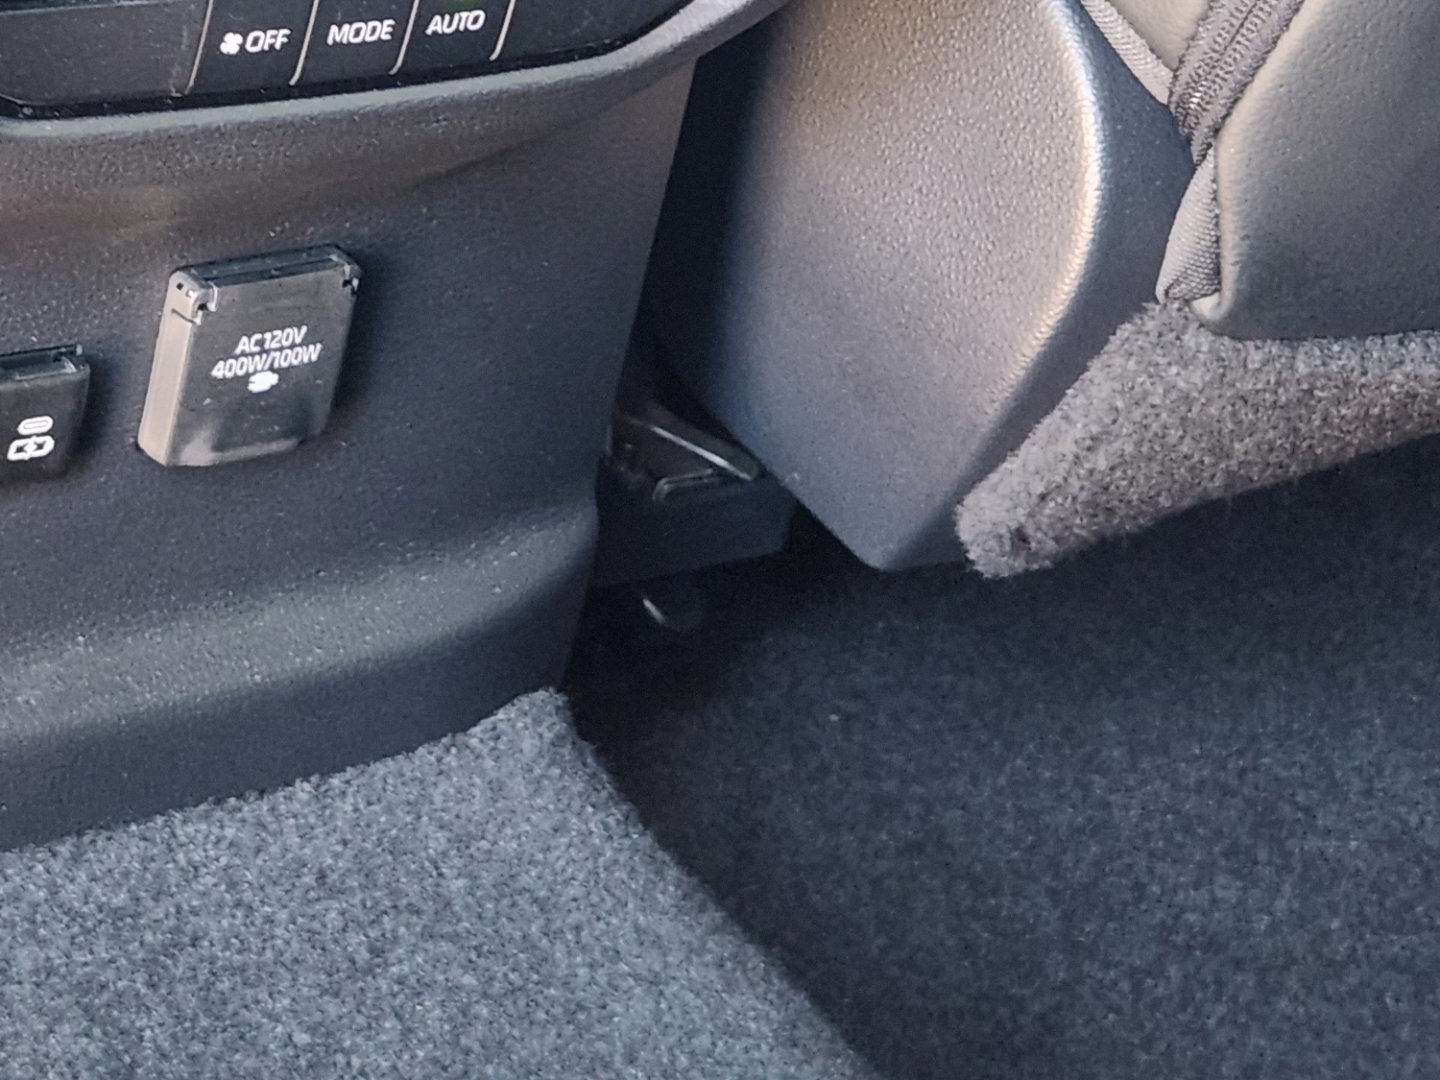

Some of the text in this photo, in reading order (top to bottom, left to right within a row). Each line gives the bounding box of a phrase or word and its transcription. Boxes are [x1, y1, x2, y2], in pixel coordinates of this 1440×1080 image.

[326, 19, 396, 46] MODE
[425, 10, 486, 35] AUTO
[244, 28, 291, 52] OFF
[210, 342, 323, 379] 400W/100W
